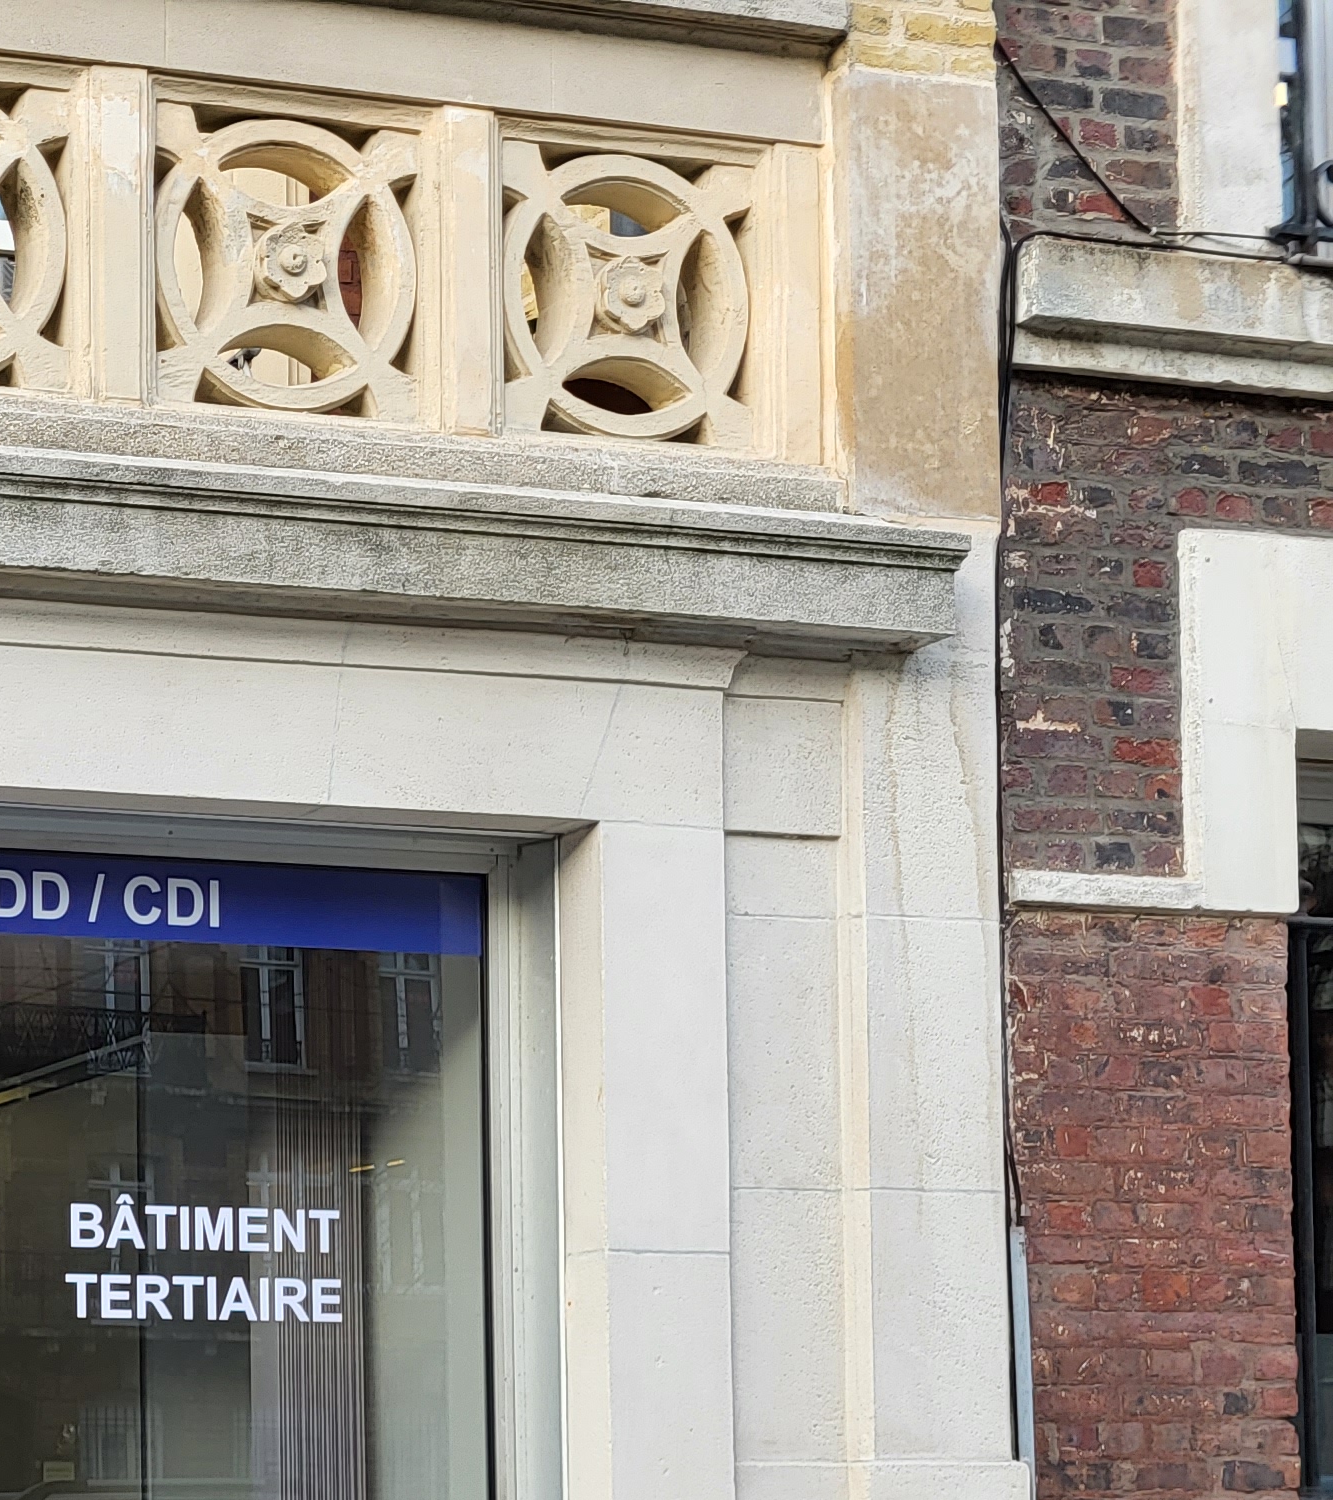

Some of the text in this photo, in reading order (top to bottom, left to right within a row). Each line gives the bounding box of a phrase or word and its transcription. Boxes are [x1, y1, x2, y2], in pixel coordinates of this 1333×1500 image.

[89, 874, 104, 922] /
[124, 877, 219, 927] CDI
[71, 1194, 340, 1253] BÂTIMENT
[65, 1274, 342, 1322] TERTIAIRE
